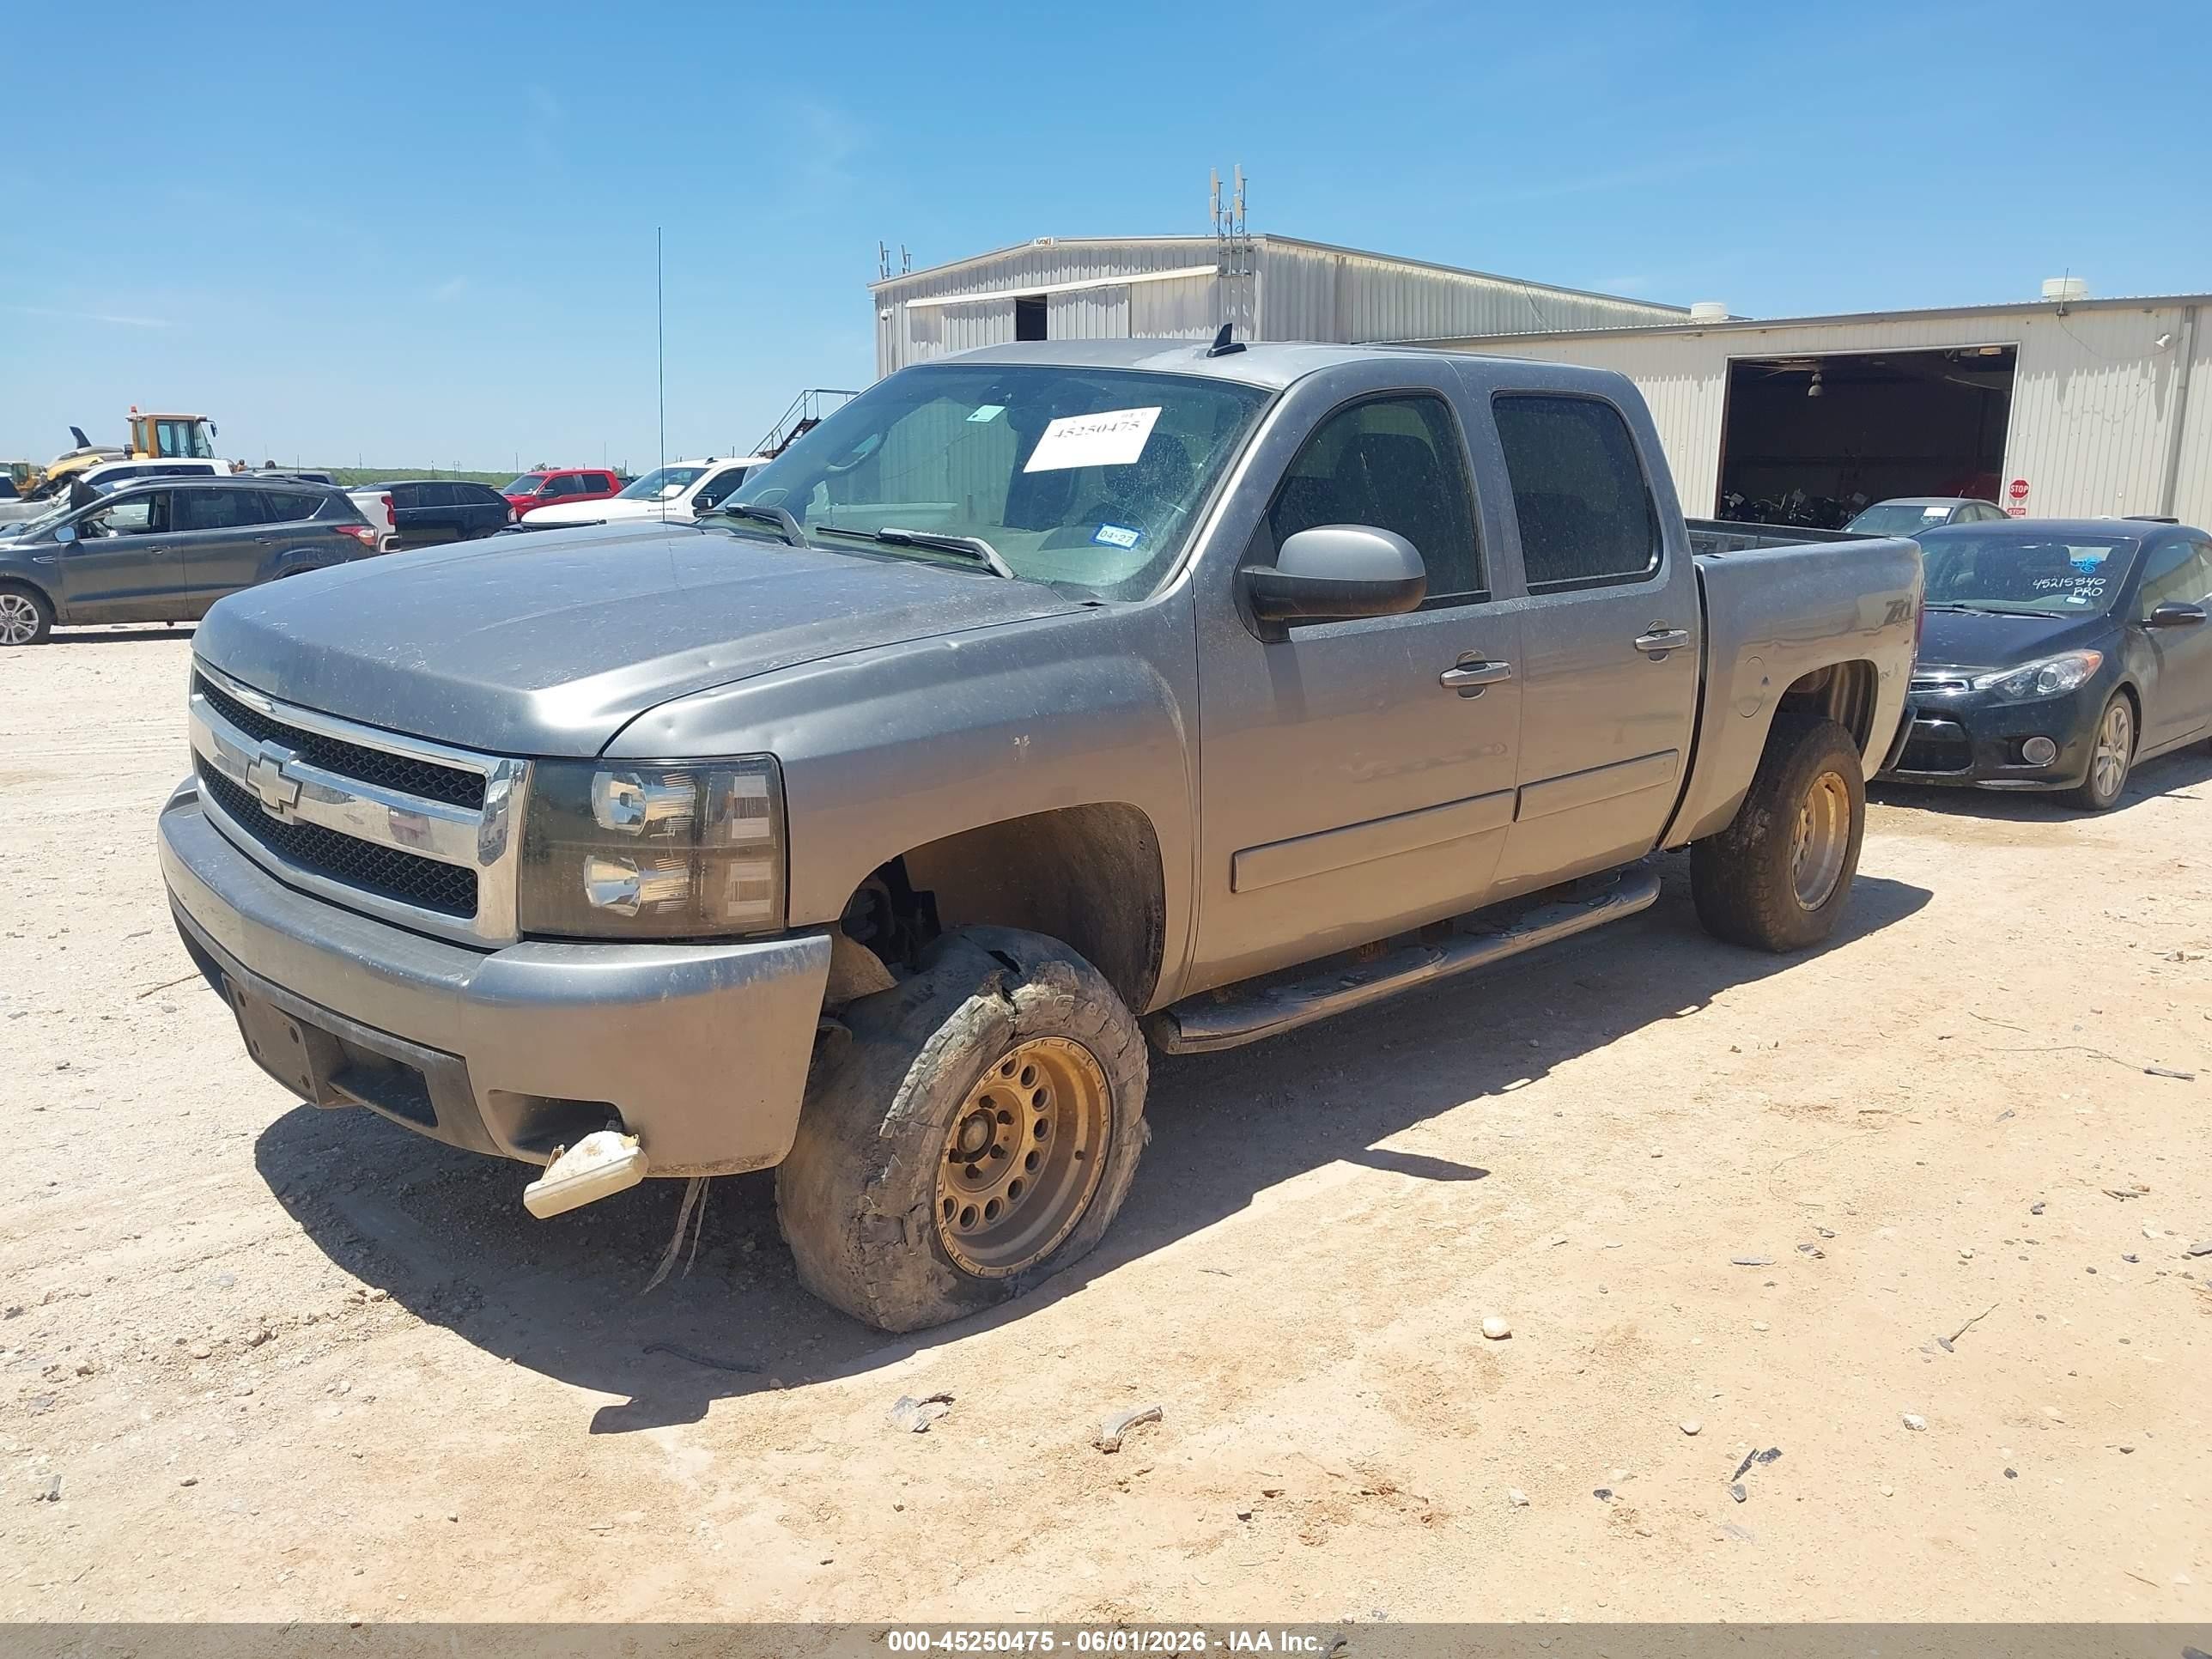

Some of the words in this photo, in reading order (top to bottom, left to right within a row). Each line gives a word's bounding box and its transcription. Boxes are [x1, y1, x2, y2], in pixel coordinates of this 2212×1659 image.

[2009, 484, 2029, 493] STOP
[2033, 577, 2106, 590] 45215840
[2073, 586, 2103, 597] PRO
